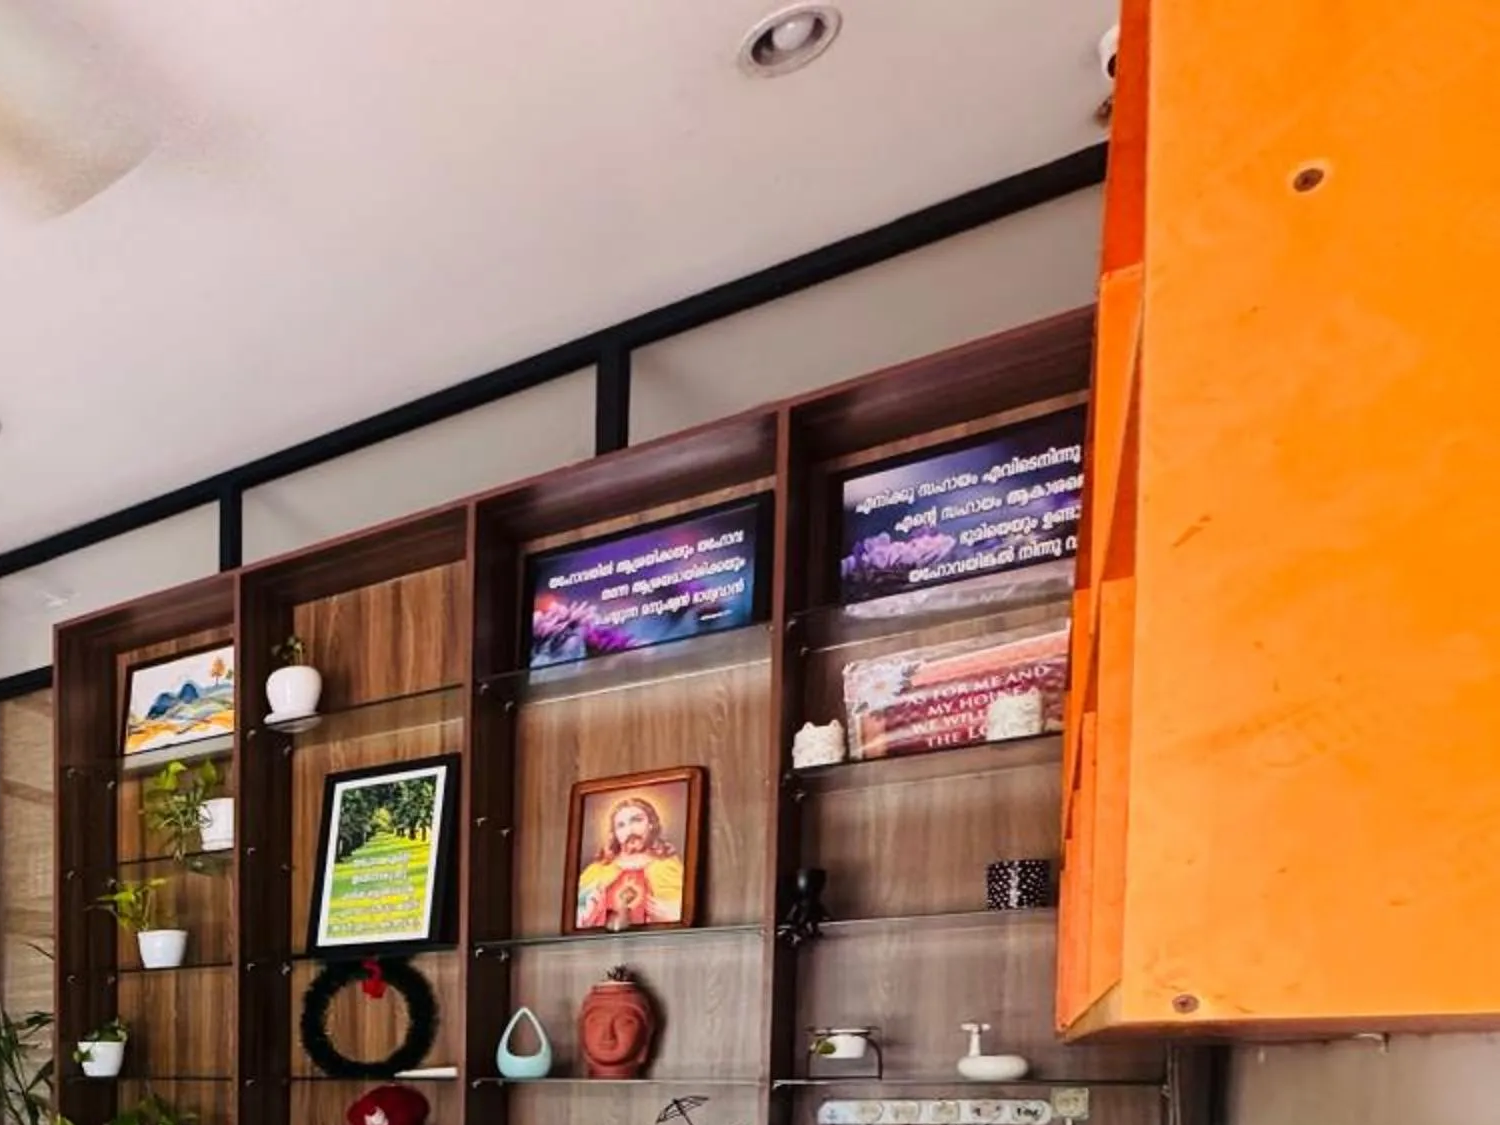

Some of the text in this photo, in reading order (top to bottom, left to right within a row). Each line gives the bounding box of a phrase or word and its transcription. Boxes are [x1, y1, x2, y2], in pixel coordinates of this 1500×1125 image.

[918, 472, 978, 499] സഹായം
[941, 497, 1002, 520] സഹായം
[932, 682, 969, 701] FOR
[974, 674, 1002, 691] ME
[1004, 664, 1051, 685] AND
[927, 700, 954, 717] MY
[927, 731, 959, 749] THE
